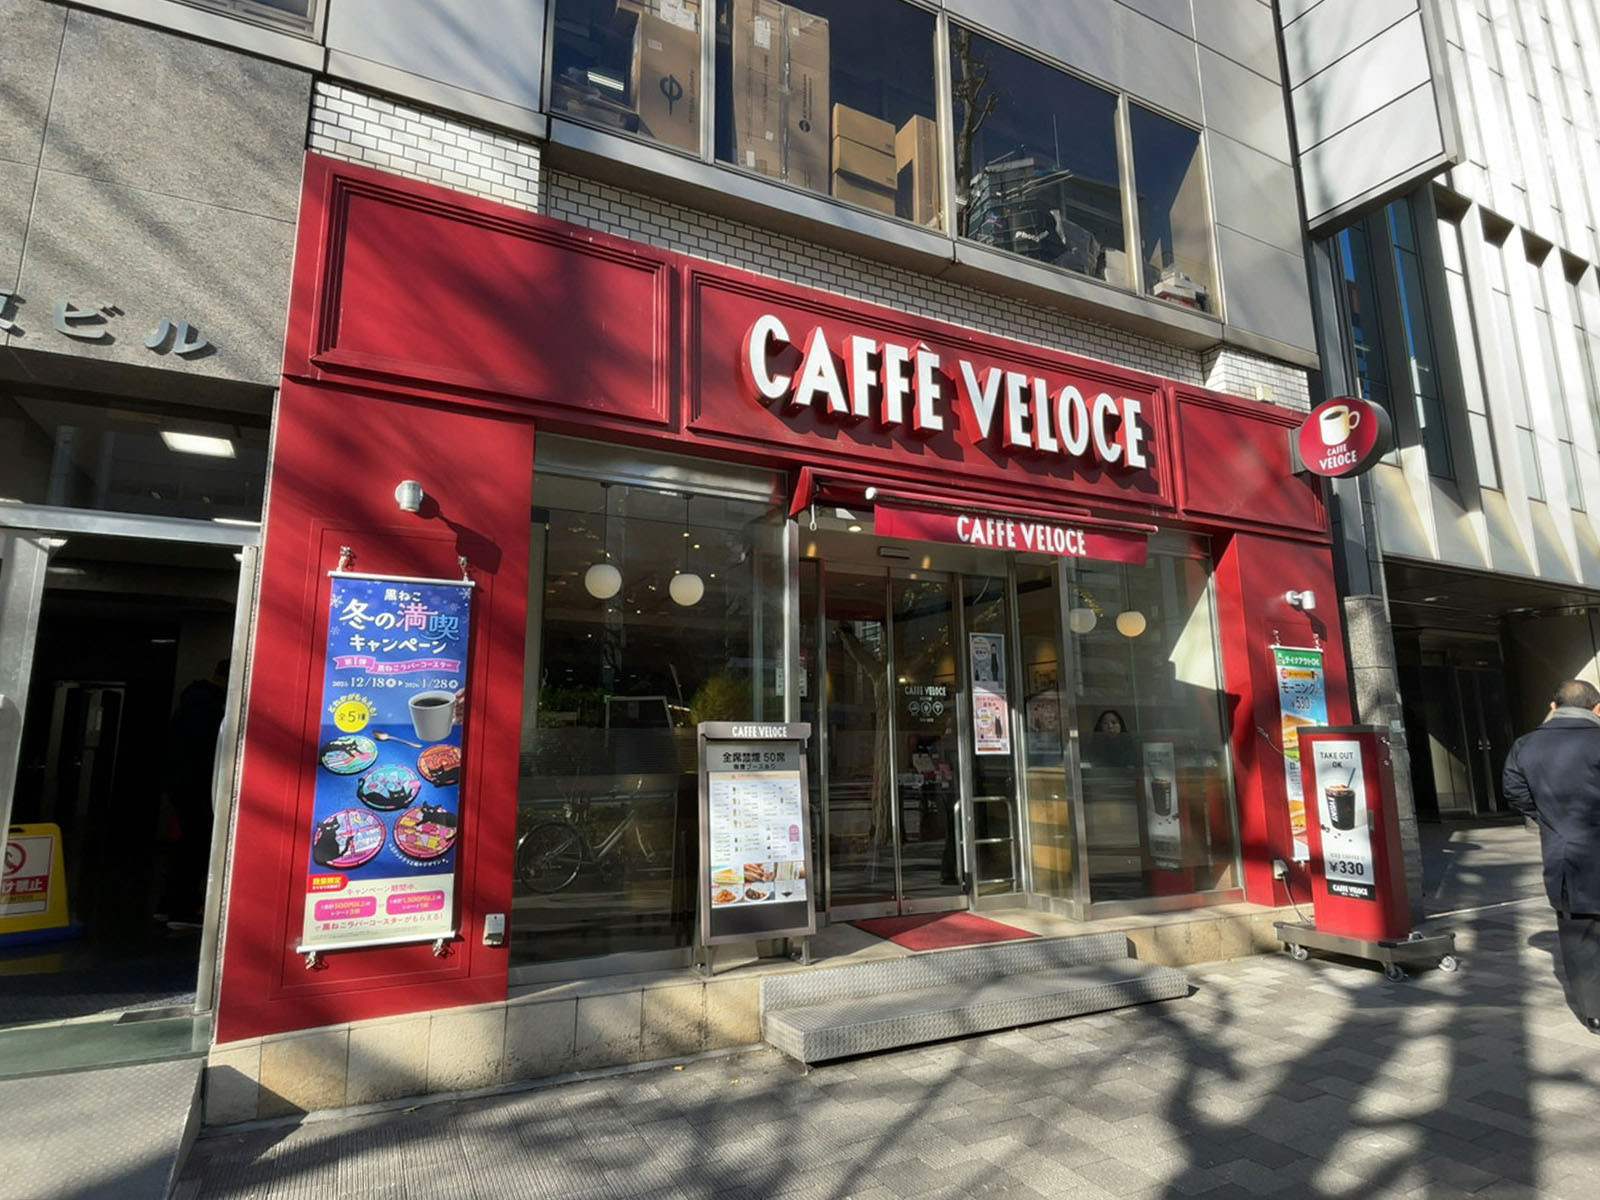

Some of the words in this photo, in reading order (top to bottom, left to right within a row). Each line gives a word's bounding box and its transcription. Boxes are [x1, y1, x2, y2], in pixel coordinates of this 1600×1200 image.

[0, 288, 207, 353] ビル
[748, 314, 944, 431] CAFFÈ
[958, 360, 1147, 469] VELOCE
[1319, 450, 1357, 471] VELOCE
[1020, 523, 1087, 556] VELOCE
[384, 588, 421, 602] 黒ねこ
[339, 598, 459, 640] 冬の満喫
[349, 634, 448, 654] キャンペーン
[377, 662, 453, 673] 黒ねこラバーコースター
[1280, 681, 1315, 695] モーニング
[758, 726, 788, 738] VELOCE
[723, 752, 761, 763] 全席禁煙
[763, 752, 786, 762] 50席
[1320, 751, 1338, 760] TAKE
[1339, 752, 1354, 760] OUT
[1332, 761, 1343, 769] OK
[1329, 860, 1364, 876] ¥330
[1349, 886, 1369, 896] VELOCE
